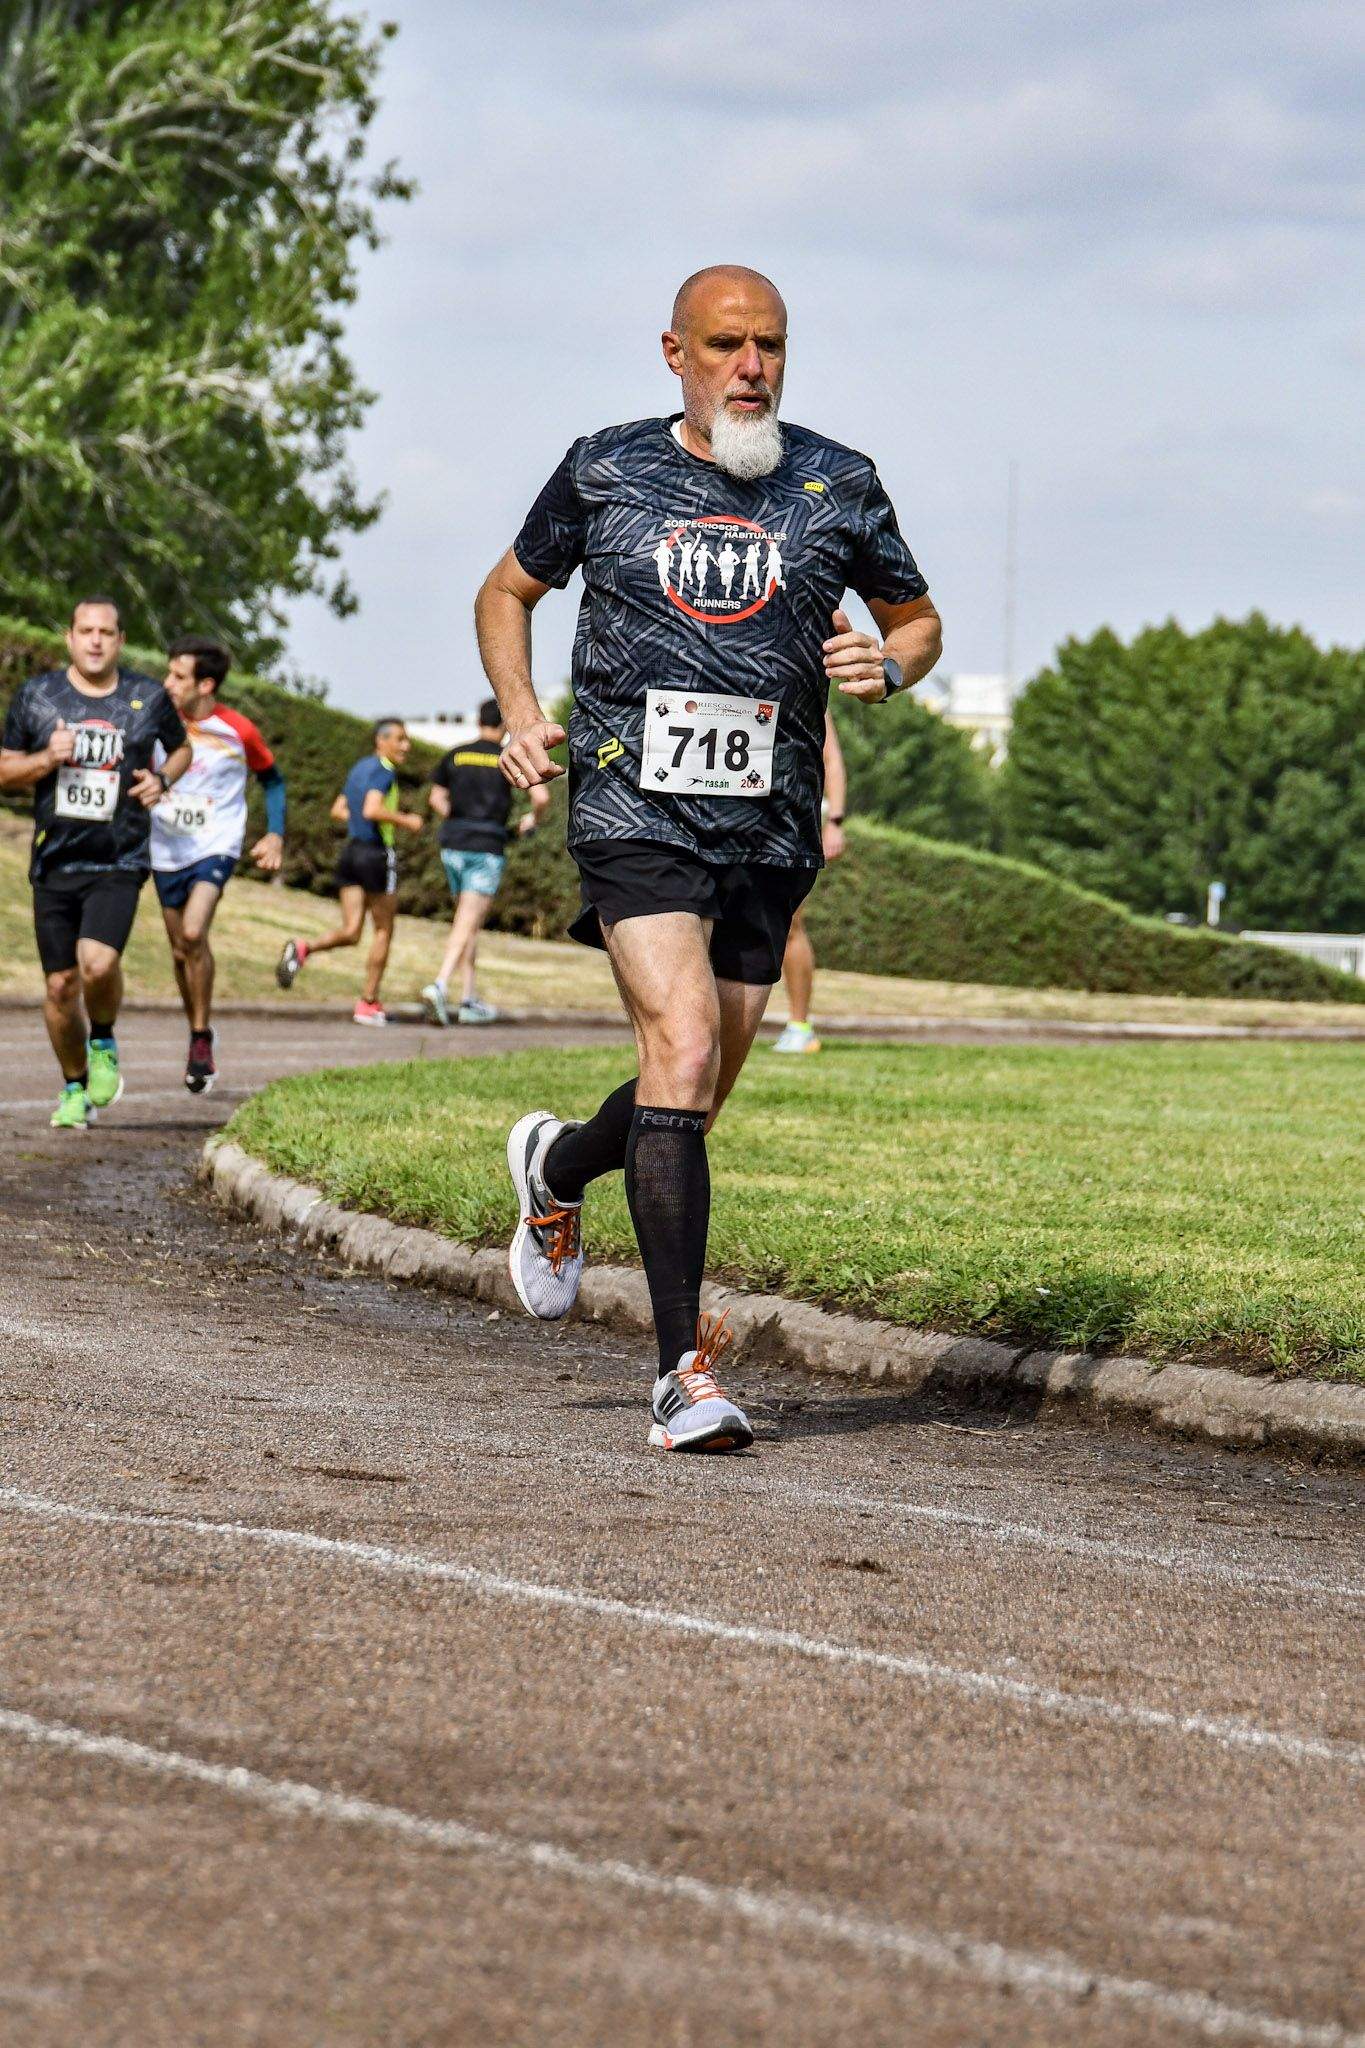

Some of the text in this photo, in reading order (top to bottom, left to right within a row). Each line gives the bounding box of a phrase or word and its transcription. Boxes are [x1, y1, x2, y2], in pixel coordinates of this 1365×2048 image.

[665, 520, 739, 532] SOSPECHOSOS
[724, 531, 787, 540] HABITUALES
[693, 599, 741, 609] RUNNERS
[668, 726, 750, 771] 718
[741, 778, 765, 789] 2023
[67, 784, 105, 806] 693
[175, 809, 205, 826] 705
